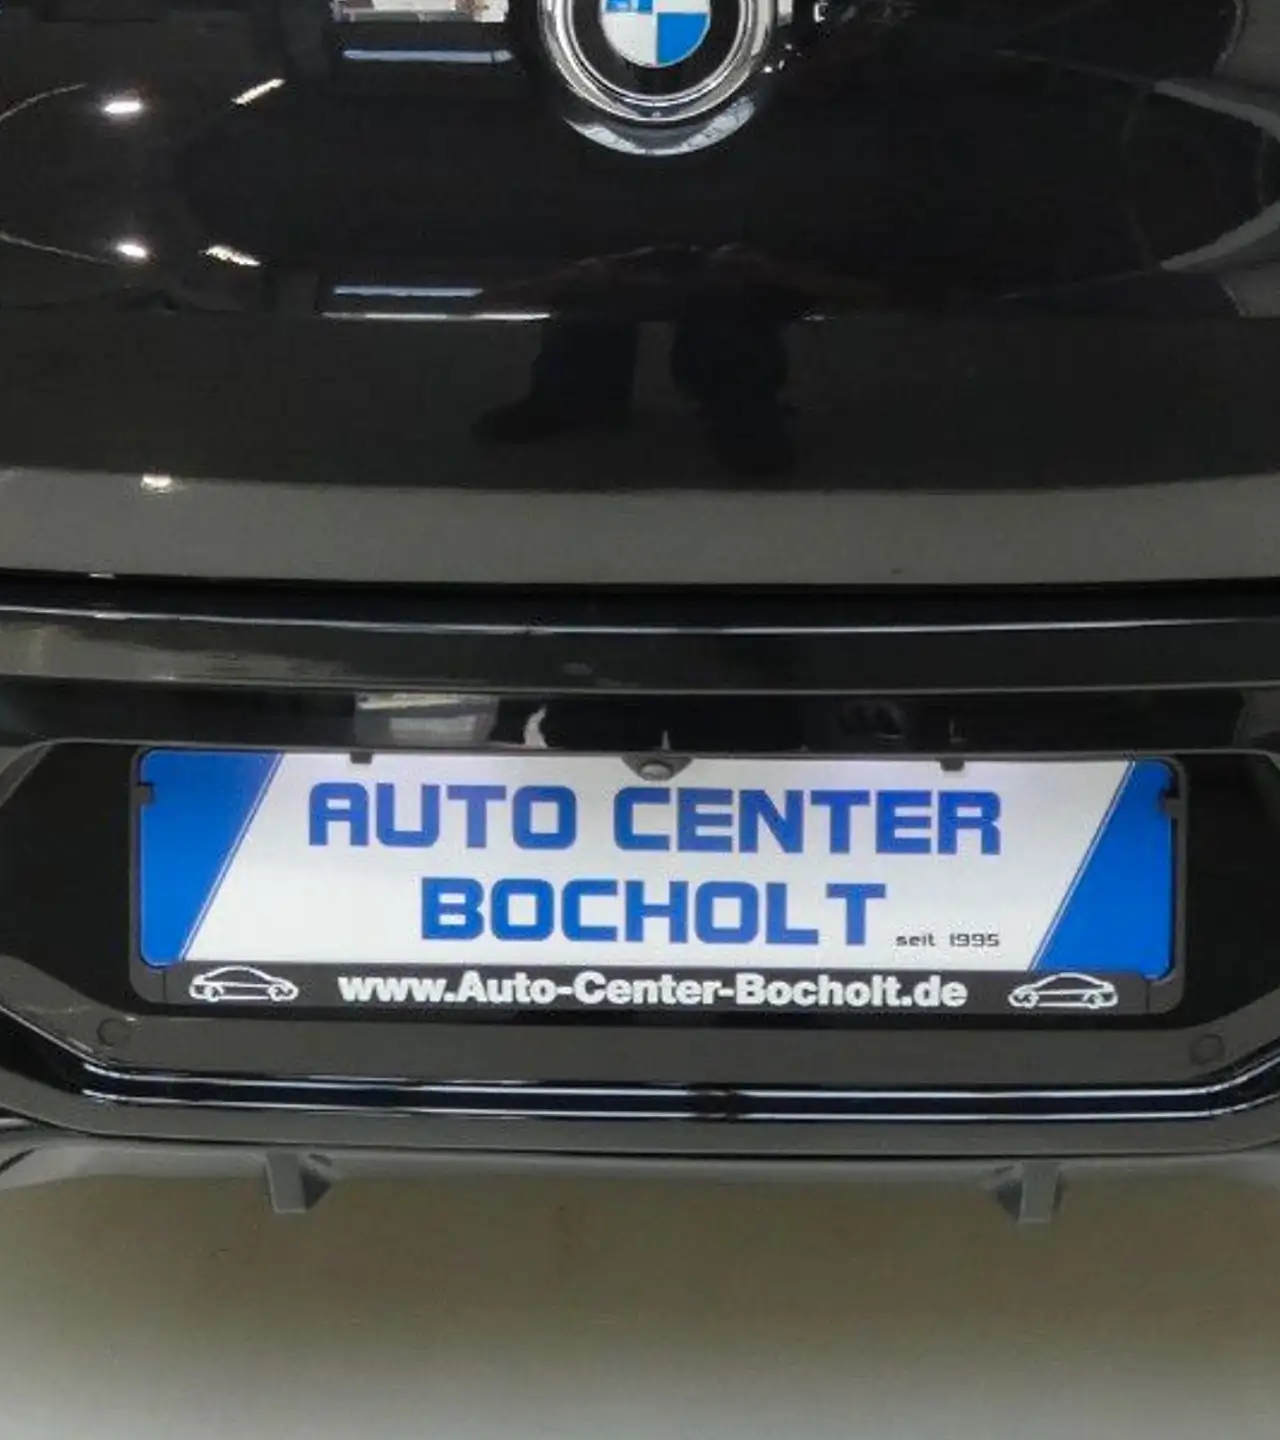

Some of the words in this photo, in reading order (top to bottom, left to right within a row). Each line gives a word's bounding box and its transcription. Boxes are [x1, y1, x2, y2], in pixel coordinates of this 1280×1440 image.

[308, 780, 577, 851] AUTO
[613, 787, 1001, 856] CENTER
[421, 875, 885, 945] BOCHOLT
[895, 933, 936, 947] seit
[949, 933, 1000, 947] 1995
[337, 969, 968, 1009] www.Auto-Center-Bocholt.de
